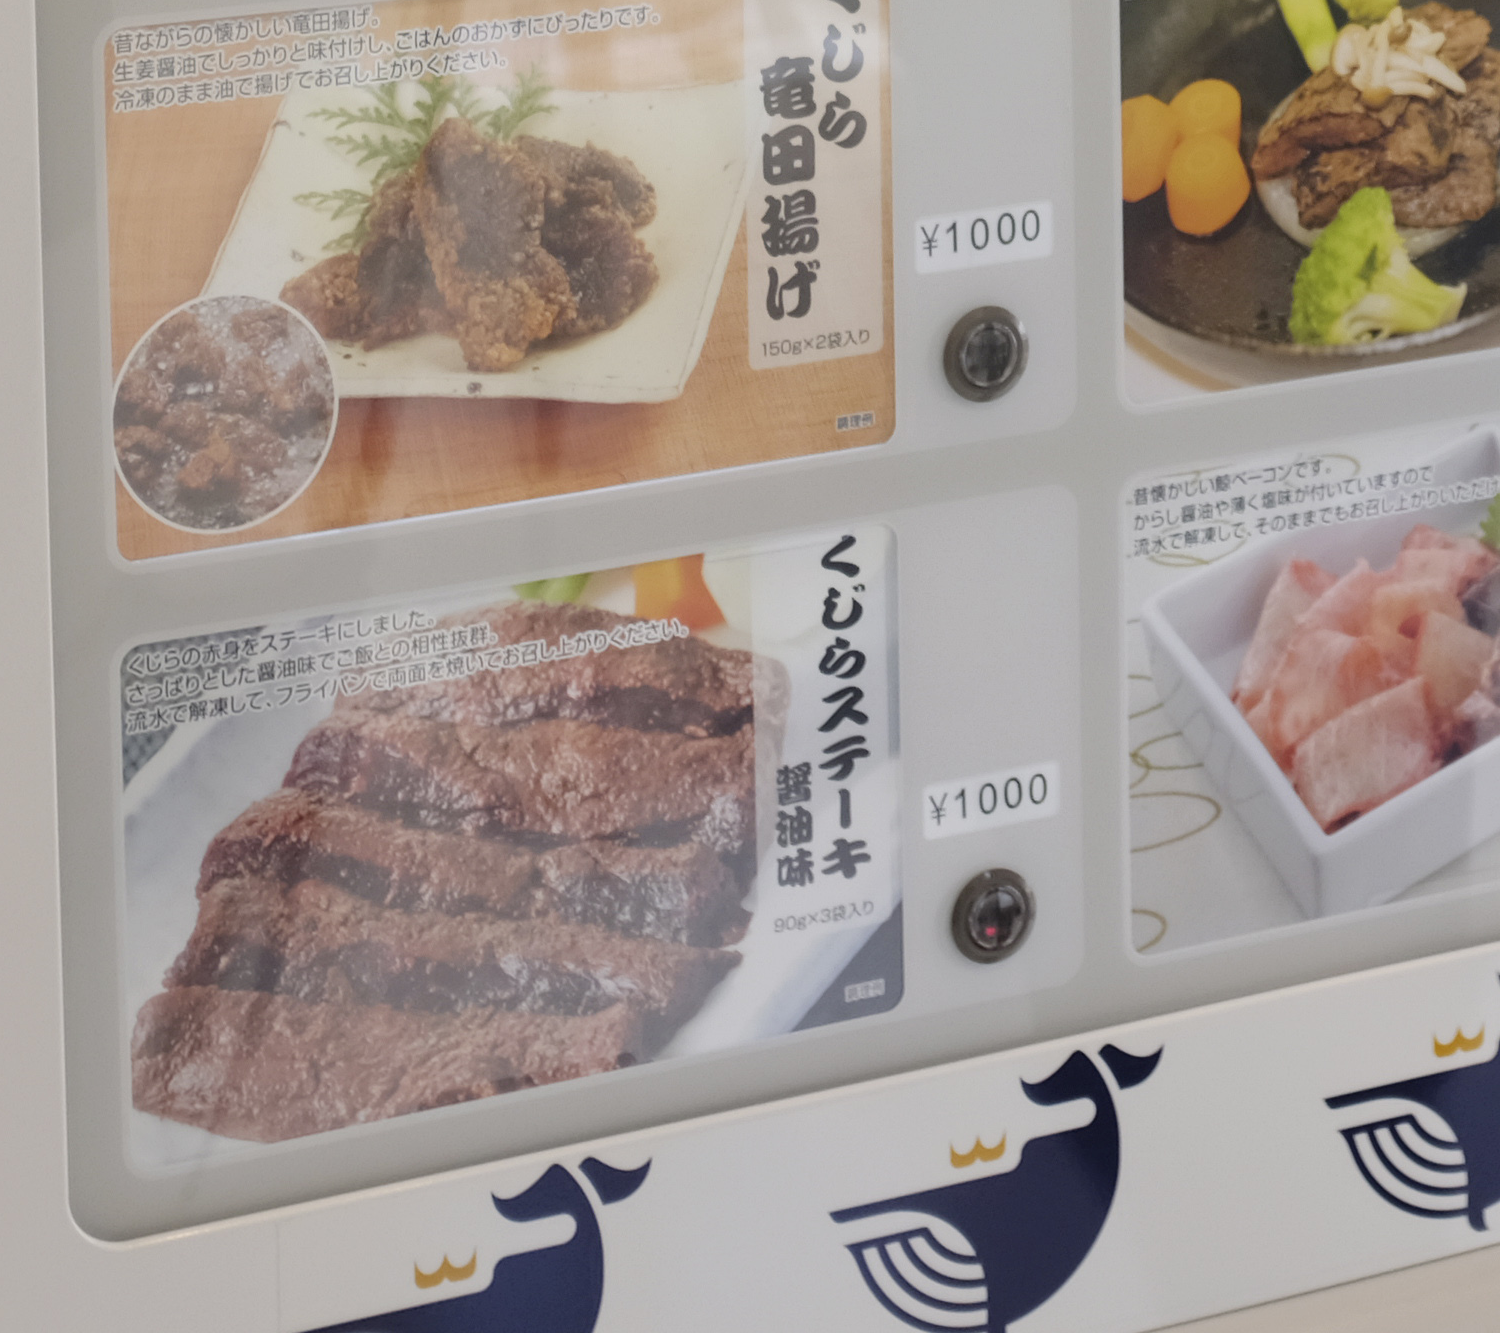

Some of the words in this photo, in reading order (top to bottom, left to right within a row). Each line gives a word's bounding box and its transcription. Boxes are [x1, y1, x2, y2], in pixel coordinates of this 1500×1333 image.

[759, 56, 821, 321] 竜田揚げ
[920, 209, 1041, 258] ¥1000
[817, 534, 871, 879] くじらステーキ
[775, 761, 815, 888] 醤油味
[929, 772, 1048, 826] ¥1000
